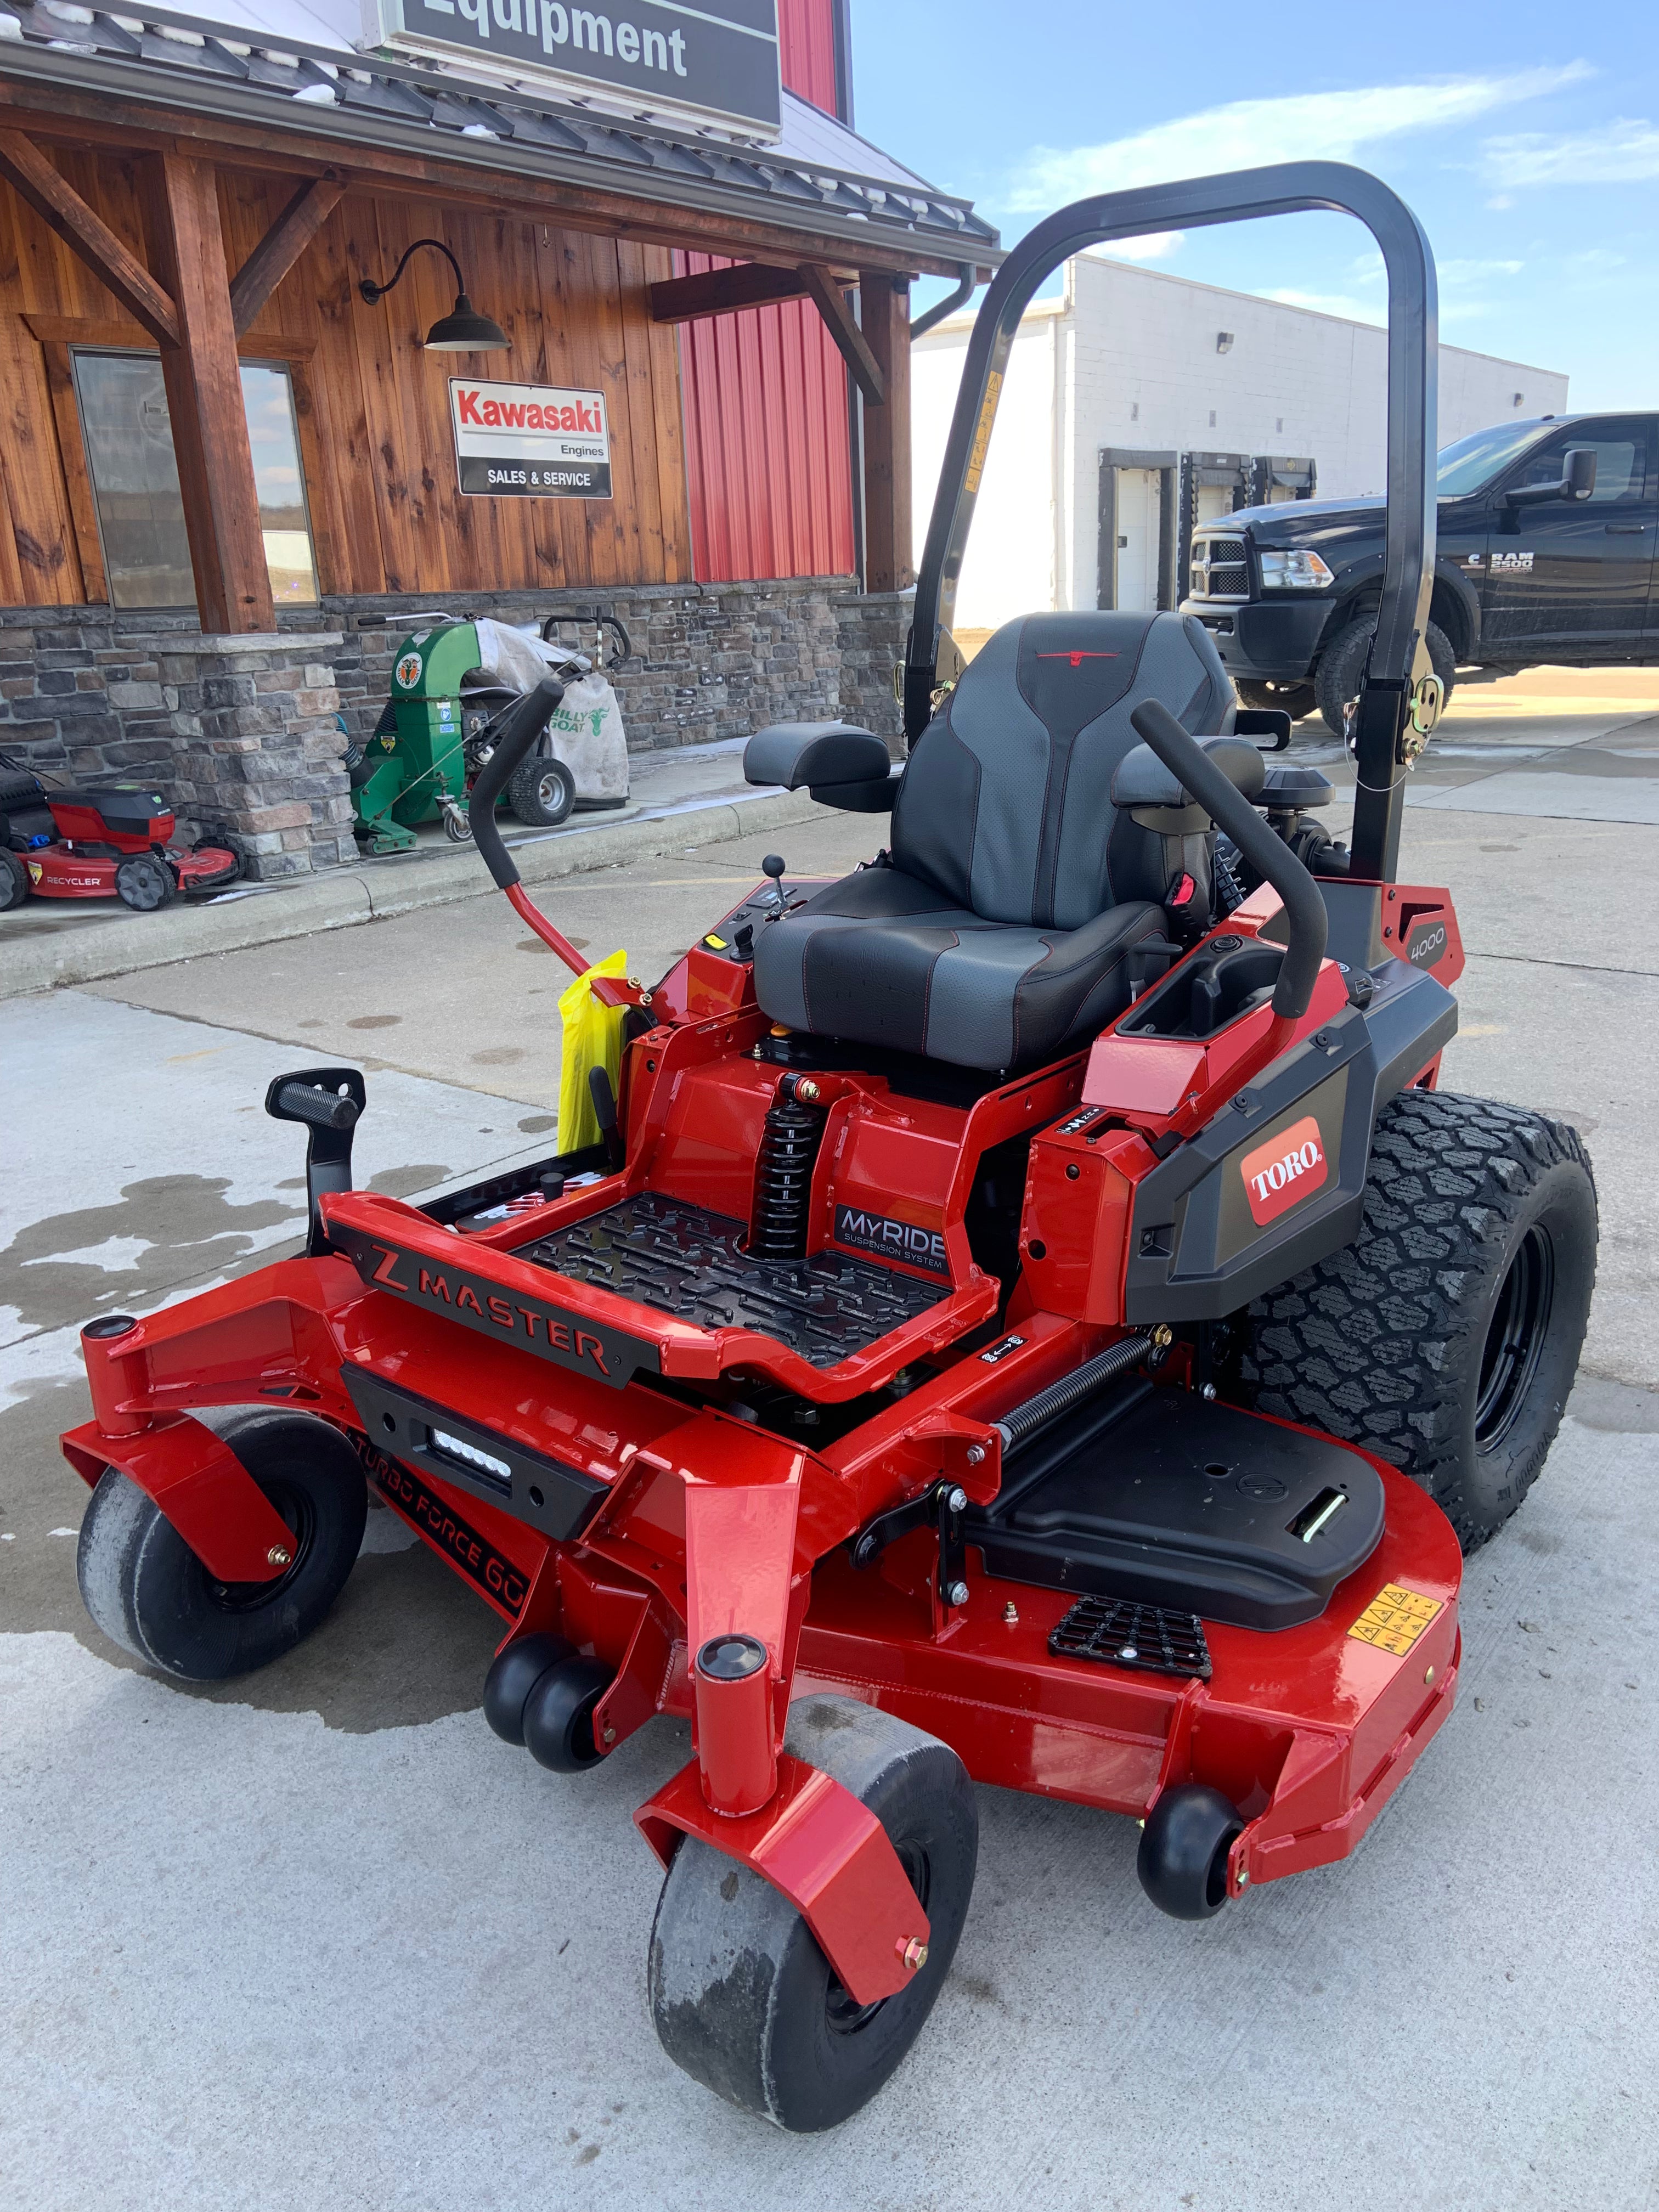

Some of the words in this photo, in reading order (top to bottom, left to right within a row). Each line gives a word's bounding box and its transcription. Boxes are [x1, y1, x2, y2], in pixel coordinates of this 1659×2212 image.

[424, 0, 688, 77] quipment
[458, 390, 602, 433] Kawasaki
[561, 444, 604, 457] Engines
[488, 469, 527, 484] SALES
[531, 471, 539, 485] &
[544, 471, 591, 486] SERVICE
[1491, 552, 1534, 561] RAM
[1491, 560, 1533, 568] 2500
[411, 669, 420, 685] GOAT
[552, 708, 589, 722] BILLY
[47, 877, 101, 885] RECYCLER
[1411, 927, 1444, 961] 4000
[1251, 1141, 1318, 1201] TORO
[844, 1233, 901, 1256] SUSPENSION
[904, 1251, 943, 1269] SYSTEM
[370, 1243, 409, 1293] Z
[419, 1268, 611, 1376] MASTER
[356, 1436, 413, 1503] TURBO
[416, 1494, 483, 1567] FORCE
